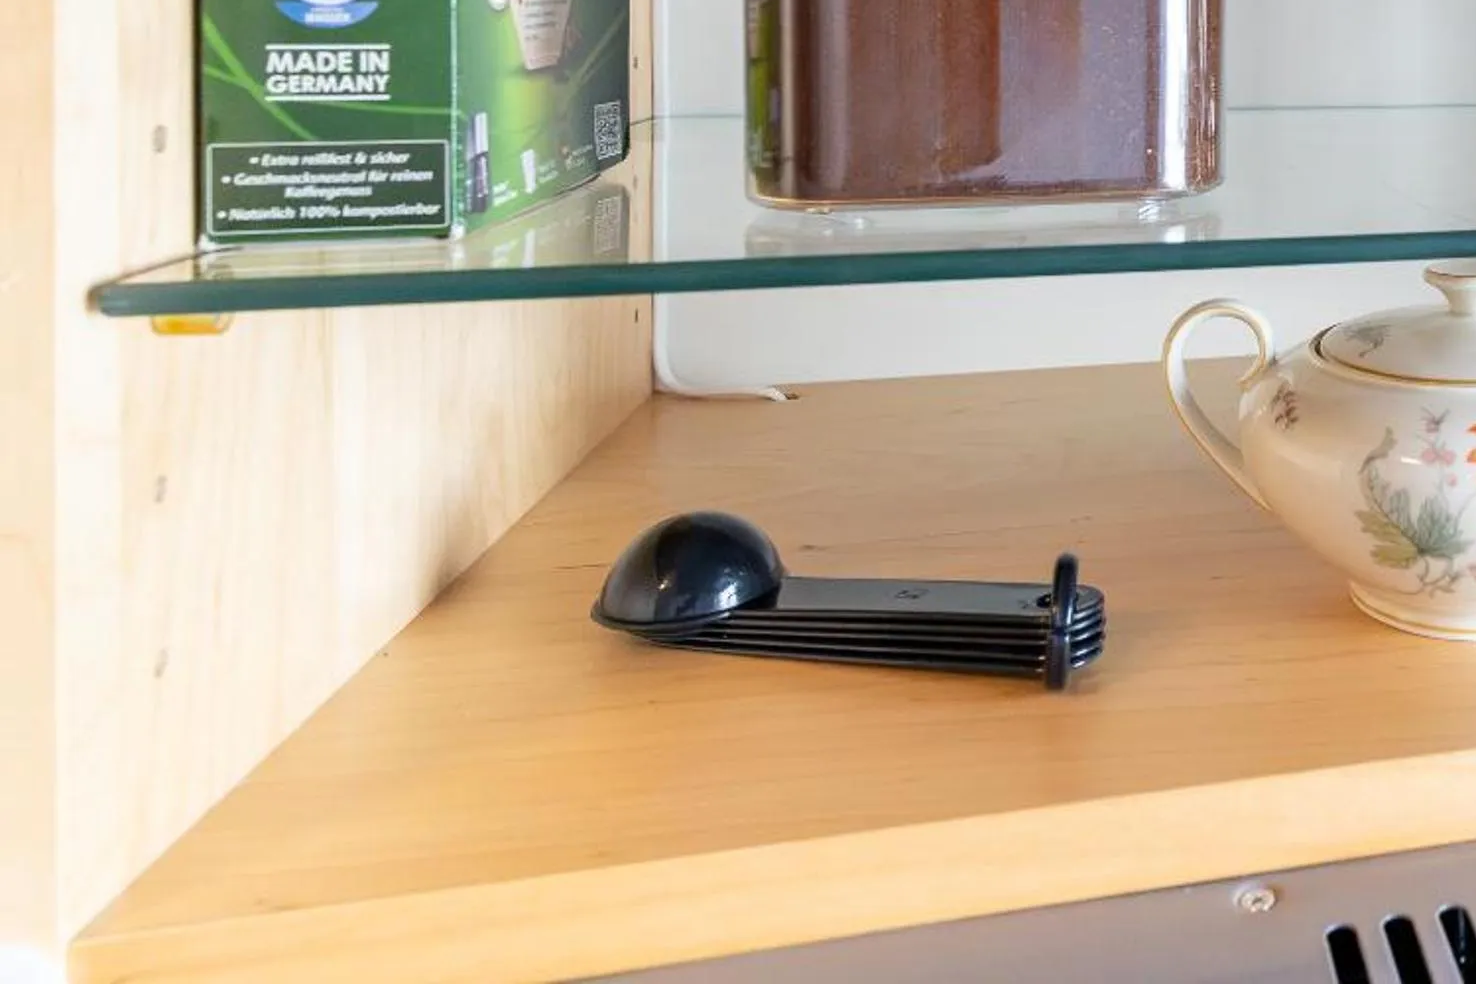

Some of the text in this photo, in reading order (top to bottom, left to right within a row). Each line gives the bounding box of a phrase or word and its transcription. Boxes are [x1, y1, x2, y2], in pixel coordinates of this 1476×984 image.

[267, 50, 389, 73] MADE IN
[265, 74, 389, 95] GERMANY
